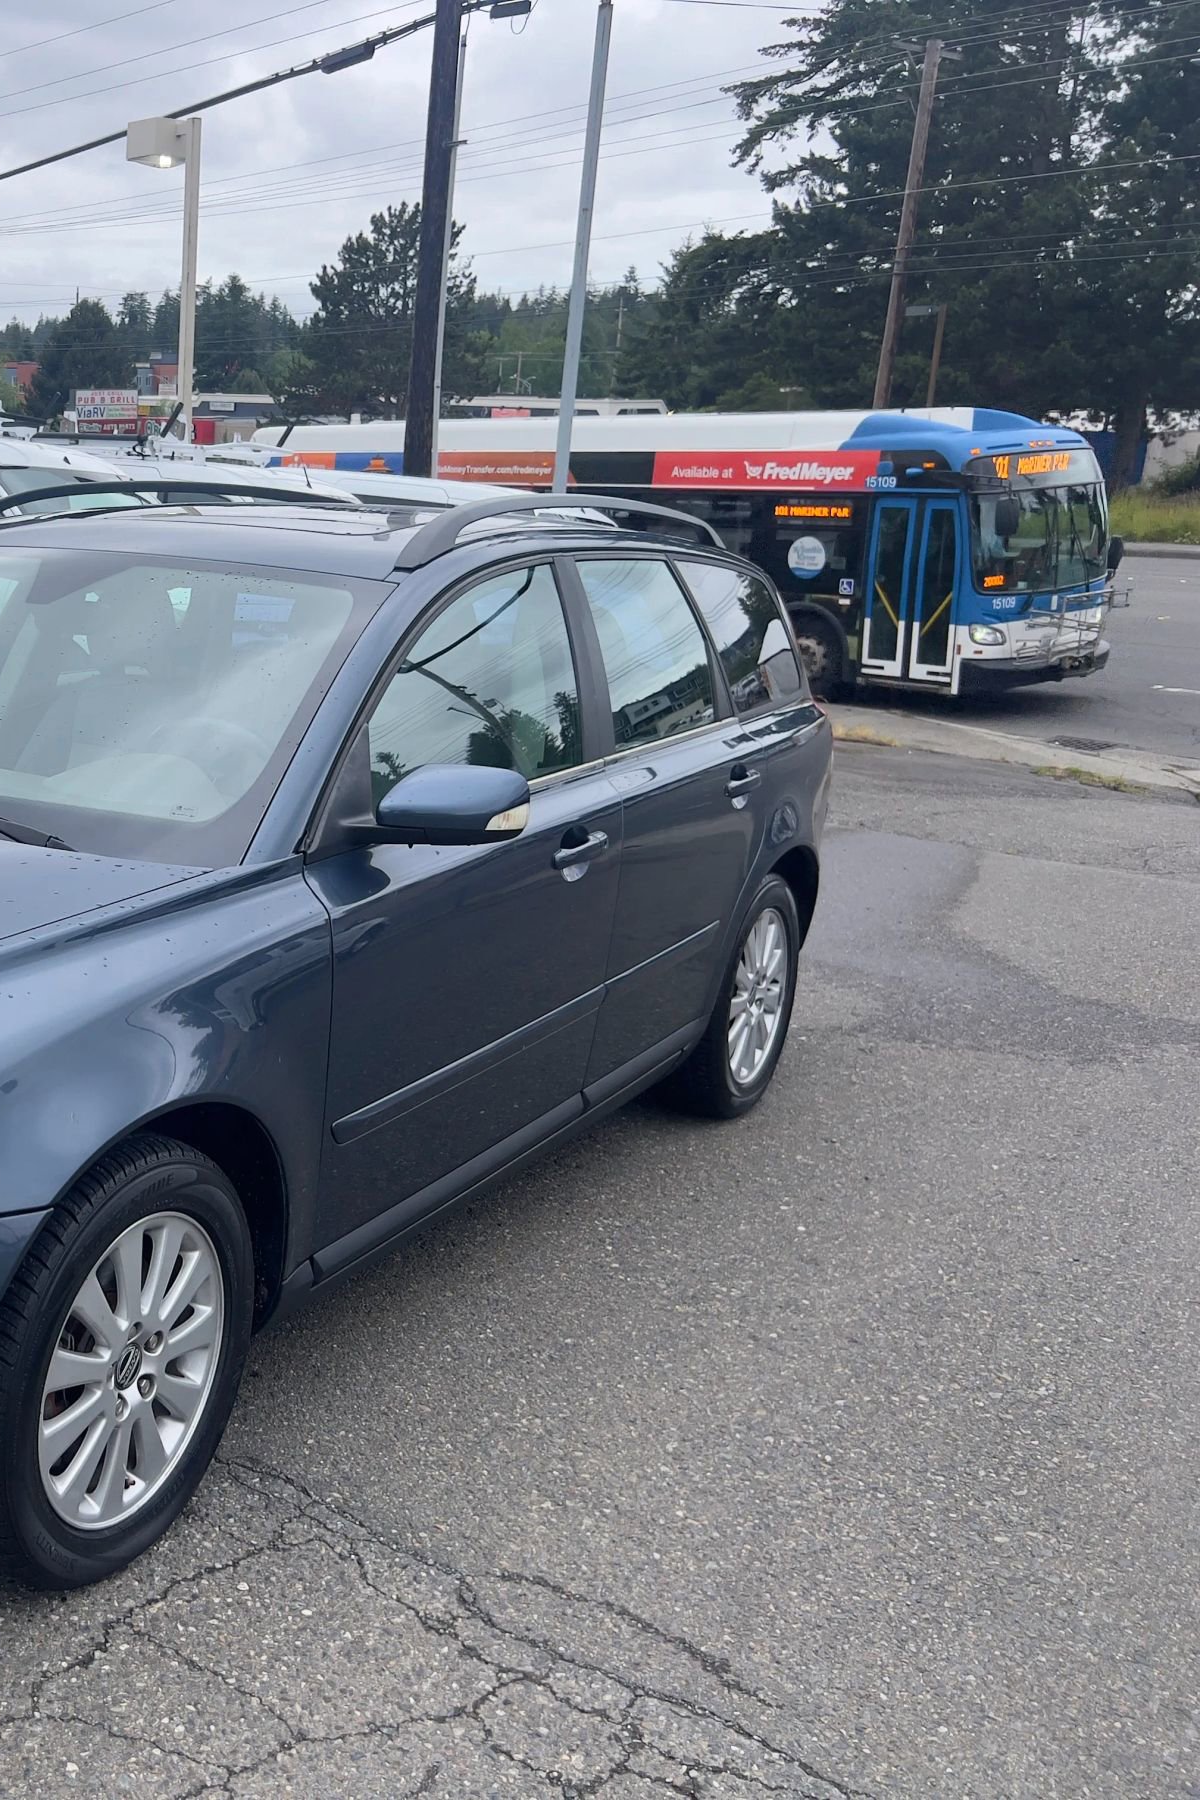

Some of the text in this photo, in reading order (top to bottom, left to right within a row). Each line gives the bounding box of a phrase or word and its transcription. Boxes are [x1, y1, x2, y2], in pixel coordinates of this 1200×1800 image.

[110, 396, 136, 404] GRILL
[1016, 454, 1052, 475] MARINER
[671, 465, 720, 479] Available
[721, 466, 733, 479] at
[865, 476, 897, 489] 15109
[790, 506, 829, 517] MARINER
[991, 596, 1016, 610] 15109
